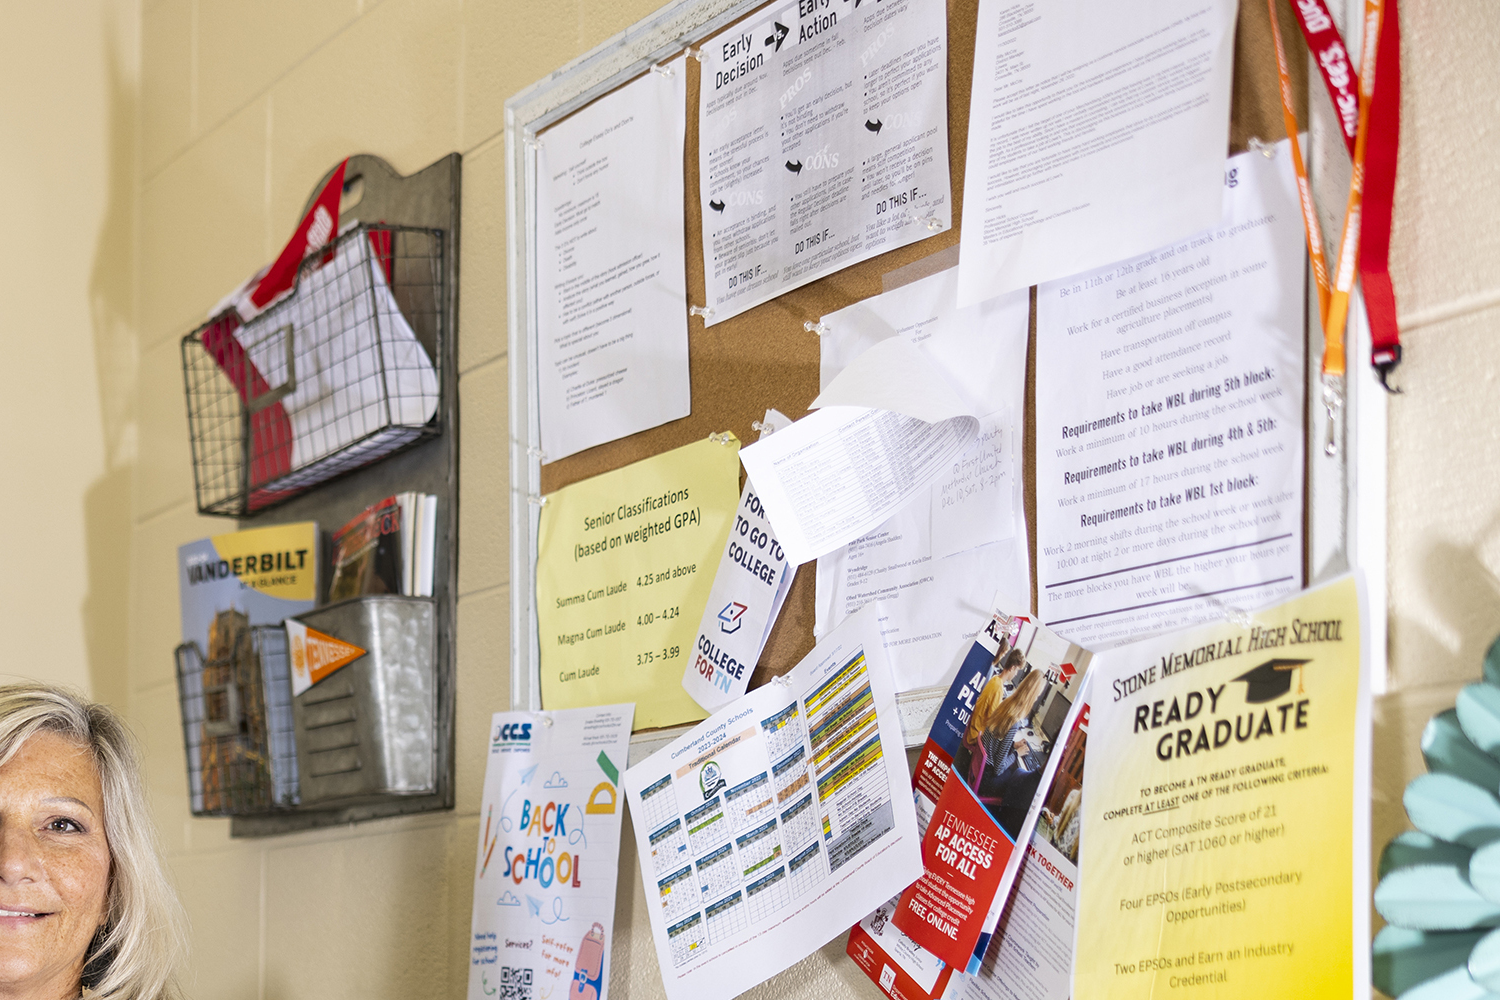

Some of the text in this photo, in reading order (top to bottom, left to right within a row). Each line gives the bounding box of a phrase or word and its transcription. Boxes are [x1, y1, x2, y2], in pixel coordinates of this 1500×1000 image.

[722, 34, 752, 62] Early
[799, 12, 836, 45] Action
[716, 53, 763, 90] Decision
[780, 67, 812, 109] PROS
[805, 152, 839, 170] CONS
[876, 188, 927, 215] DO THIS IF...
[795, 228, 835, 255] DO THIS IF...
[729, 264, 767, 289] DO THIS IF...
[1116, 256, 1210, 299] Be at least 16 years old
[1062, 366, 1275, 439] Requirements to take WBL during 5th block:
[1064, 417, 1277, 485] Requirements to take WBL during 4th & 5th:
[584, 488, 689, 531] Senior Classifications
[1081, 474, 1259, 528] Requirements to take WBL 1st block:
[575, 507, 701, 562] (based on weighted GPA)
[735, 515, 784, 562] TO GO TO
[187, 549, 308, 586] VANDERBILT
[729, 542, 775, 585] COLLEGE
[556, 563, 697, 609] Summa Cum Laude 4.25 and above
[558, 606, 680, 646] Magna Cum Laude 4.00 4.24
[560, 646, 680, 682] Cum Laude 3.75 3.99
[695, 655, 732, 694] FOR TN
[698, 634, 745, 680] COLLEGE
[1043, 670, 1059, 684] ALL
[1133, 684, 1226, 734] READY
[670, 708, 754, 760] Cumberland County Schools
[698, 733, 727, 753] 2023-2024
[1156, 699, 1309, 762] GRADUATE
[688, 735, 742, 769] Traditional Calendar
[1103, 766, 1329, 821] COMPLETE AT LEAST ONE OF THE FOLLOWING CRITERIA:
[1140, 789, 1151, 798] TO
[1154, 780, 1186, 795] BECOME
[1188, 779, 1194, 787] A
[1196, 775, 1207, 785] TN
[1209, 769, 1237, 782] READY
[519, 799, 570, 837] BACK
[942, 810, 998, 854] TENNESSEE
[1132, 805, 1277, 845] ACT Composite Score of 21
[542, 837, 555, 854] TO
[934, 825, 993, 869] AP ACCESS
[935, 844, 976, 881] FOR ALL
[503, 846, 581, 889] SCHOOL
[1037, 852, 1074, 892] TOGETHER
[1119, 871, 1302, 911] Four EPSOs (Early Postsecondary
[909, 899, 926, 921] FREE,
[927, 912, 958, 940] ONLINE.
[1166, 899, 1246, 924] Opportunities)
[505, 939, 533, 950] Services?
[884, 970, 892, 984] TN
